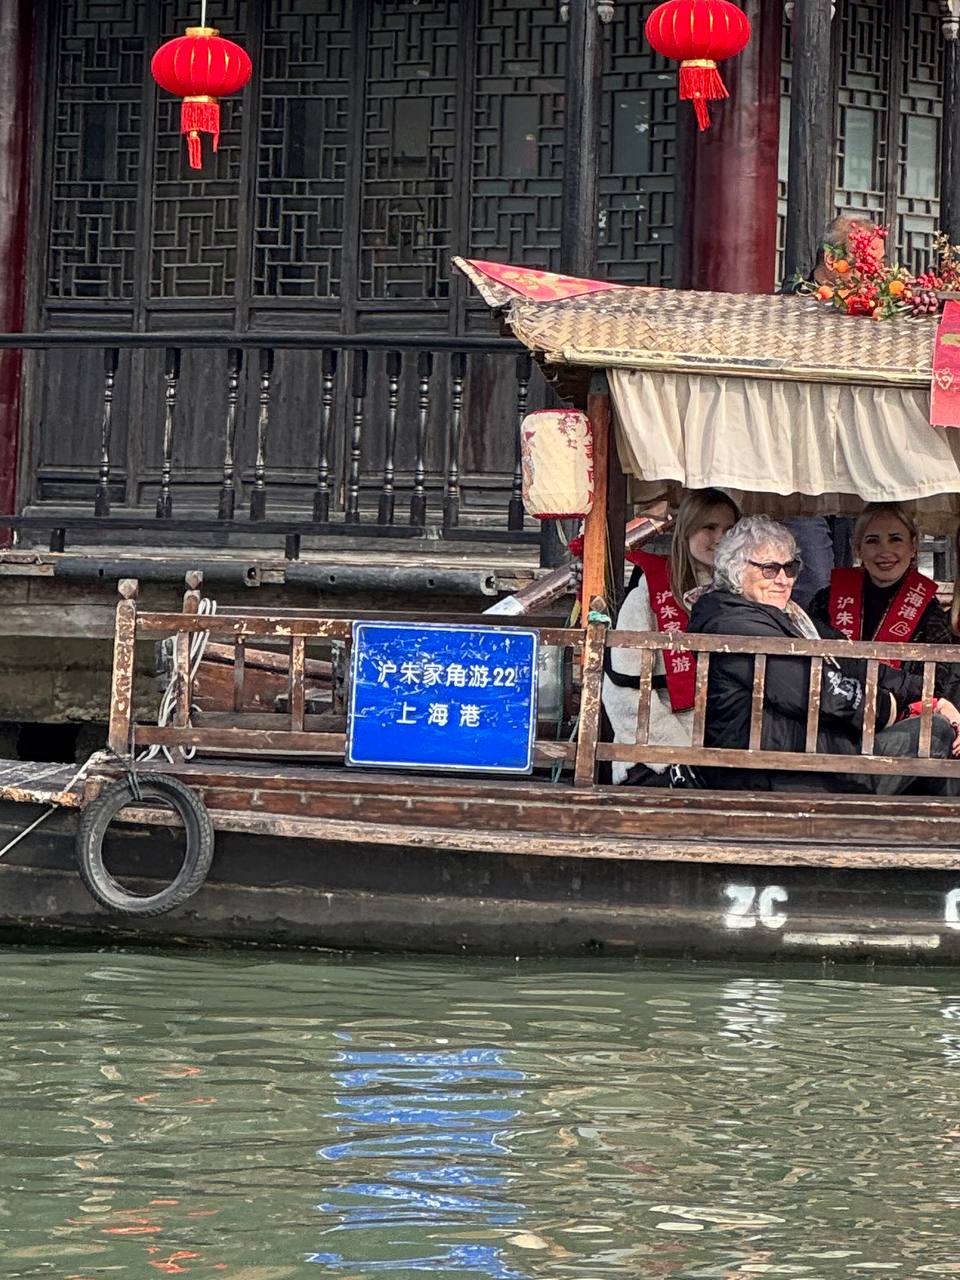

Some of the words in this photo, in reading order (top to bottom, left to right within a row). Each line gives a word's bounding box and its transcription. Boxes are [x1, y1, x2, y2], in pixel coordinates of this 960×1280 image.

[897, 582, 927, 621] 上海港
[377, 660, 516, 688] 沪朱家角游22
[396, 701, 481, 728] 上海港
[723, 883, 789, 929] ZC
